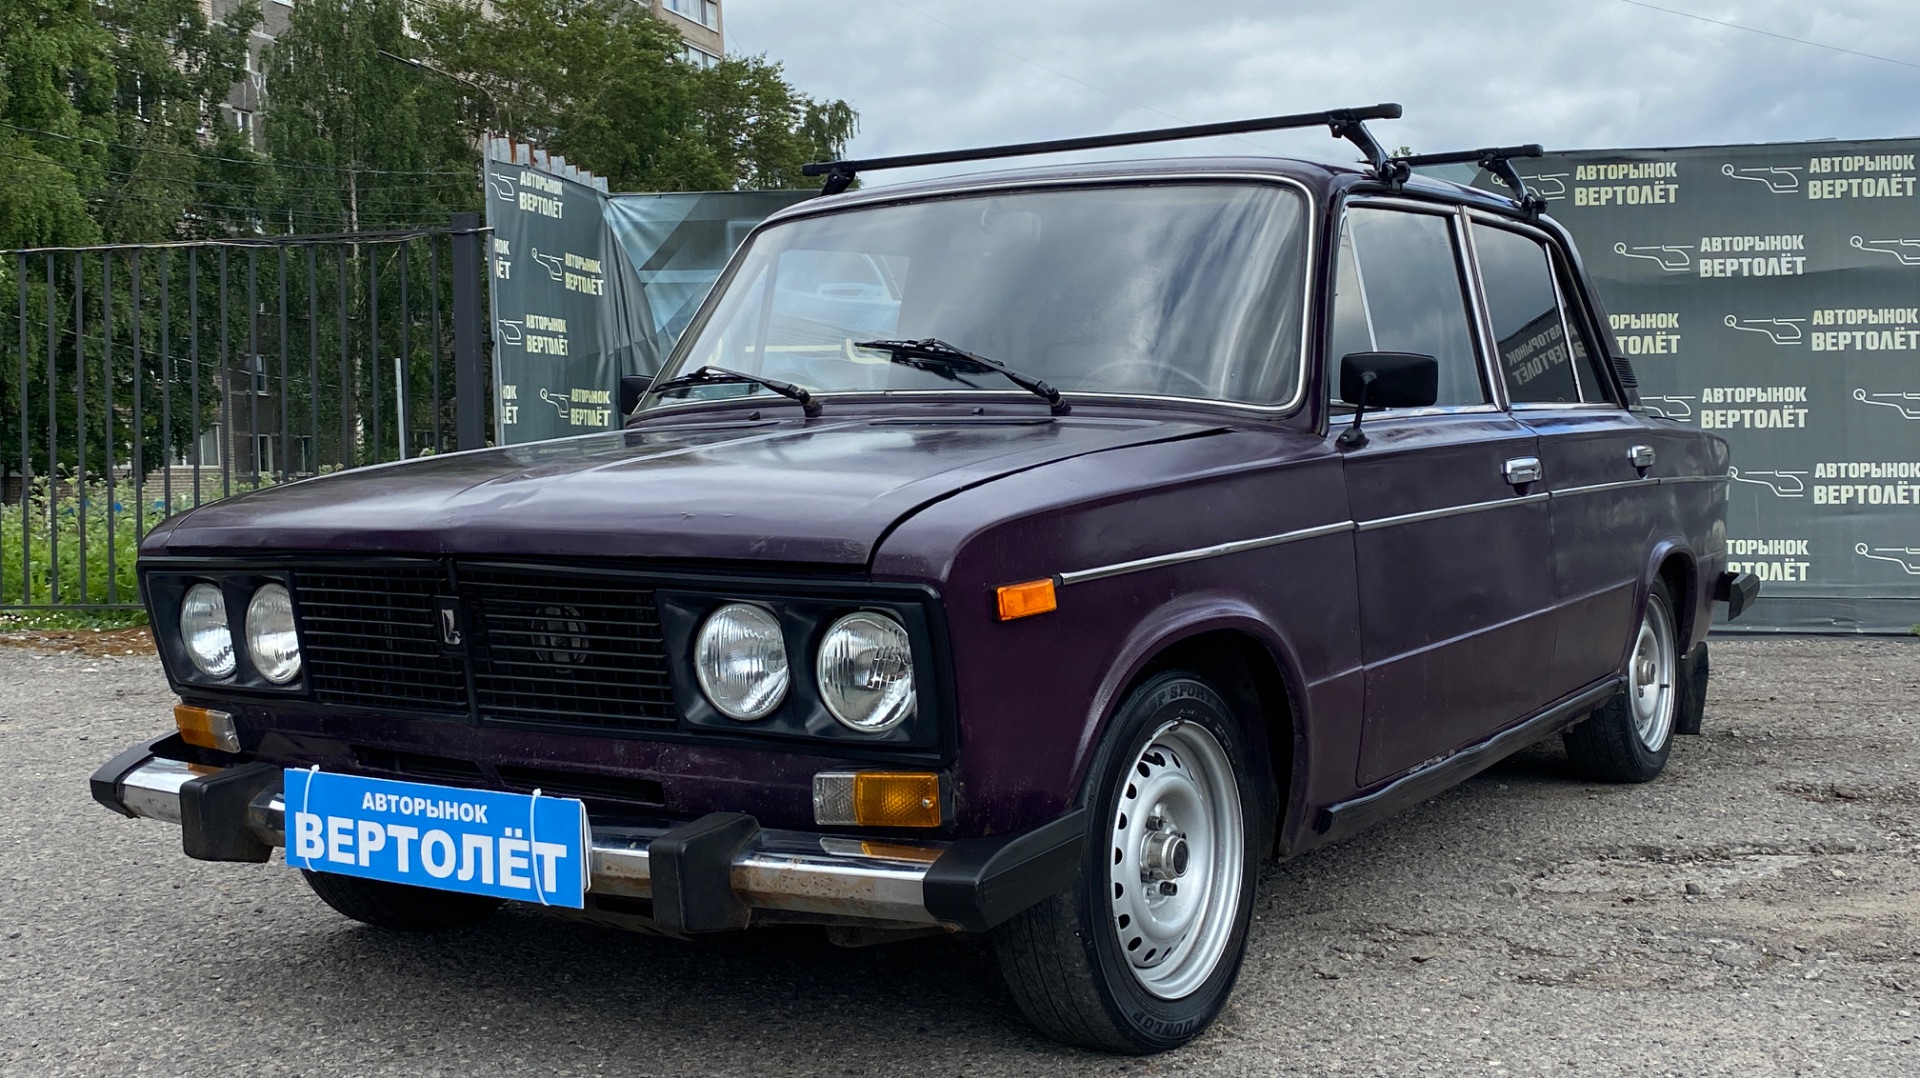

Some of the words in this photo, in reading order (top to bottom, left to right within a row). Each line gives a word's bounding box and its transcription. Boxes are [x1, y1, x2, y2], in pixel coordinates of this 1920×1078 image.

[1575, 162, 1678, 181] АВТОРЫНОК
[1809, 154, 1916, 174] АВТОРЫНОК
[520, 171, 564, 196] АВТОРЫНОК
[1574, 180, 1679, 206] ВЕРТОЛЁТ
[1808, 172, 1917, 200] ВЕРТОЛЁТ
[519, 191, 564, 219] ВЕРТОЛЁТ
[1700, 234, 1805, 253] АВТОРЫНОК
[1700, 253, 1807, 278] ВЕРТОЛЁТ
[565, 271, 604, 296] ВЕРТОЛЁТ
[526, 314, 568, 333] АВТОРЫНОК
[1608, 312, 1680, 330] ОРЫНОК
[1812, 308, 1919, 326] АВТОРЫНОК
[526, 334, 569, 356] ВЕРТОЛЁТ
[1811, 326, 1920, 351] ВЕРТОЛЁТ
[571, 388, 610, 404] АВТОРЫНОК
[1702, 386, 1808, 403] АВТОРЫНОК
[570, 405, 612, 427] ВЕРТОЛЁТ
[1700, 405, 1809, 429] ВЕРТОЛЁТ
[1814, 462, 1920, 478] АВТОРЫНОК
[1813, 481, 1920, 504] ВЕРТОЛЁТ
[362, 791, 488, 824] АВТОРЫНОК
[295, 812, 567, 893] ВЕРТОЛЁТ
[1132, 1012, 1194, 1036] DUNLOP
